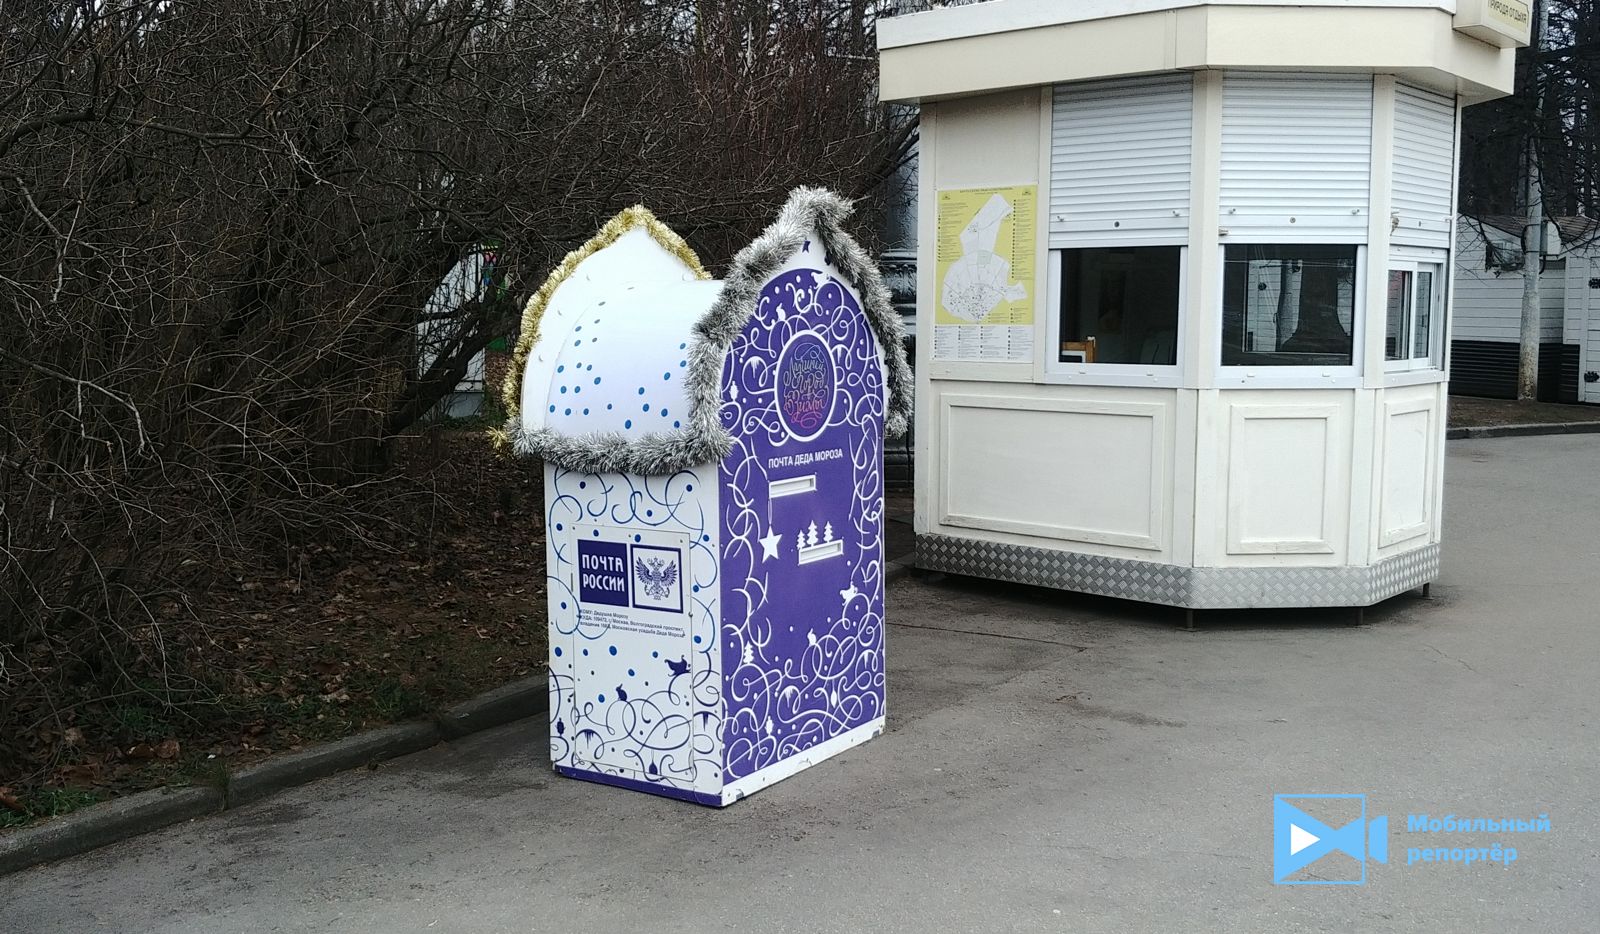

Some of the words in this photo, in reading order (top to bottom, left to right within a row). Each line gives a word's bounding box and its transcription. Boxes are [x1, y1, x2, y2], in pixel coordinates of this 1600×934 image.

[768, 456, 793, 469] ПОЧТА
[794, 452, 813, 467] ДЕДА
[815, 448, 843, 462] МОРОЗА
[581, 554, 624, 573] ПОЧТА
[583, 573, 625, 592] РОССИИ
